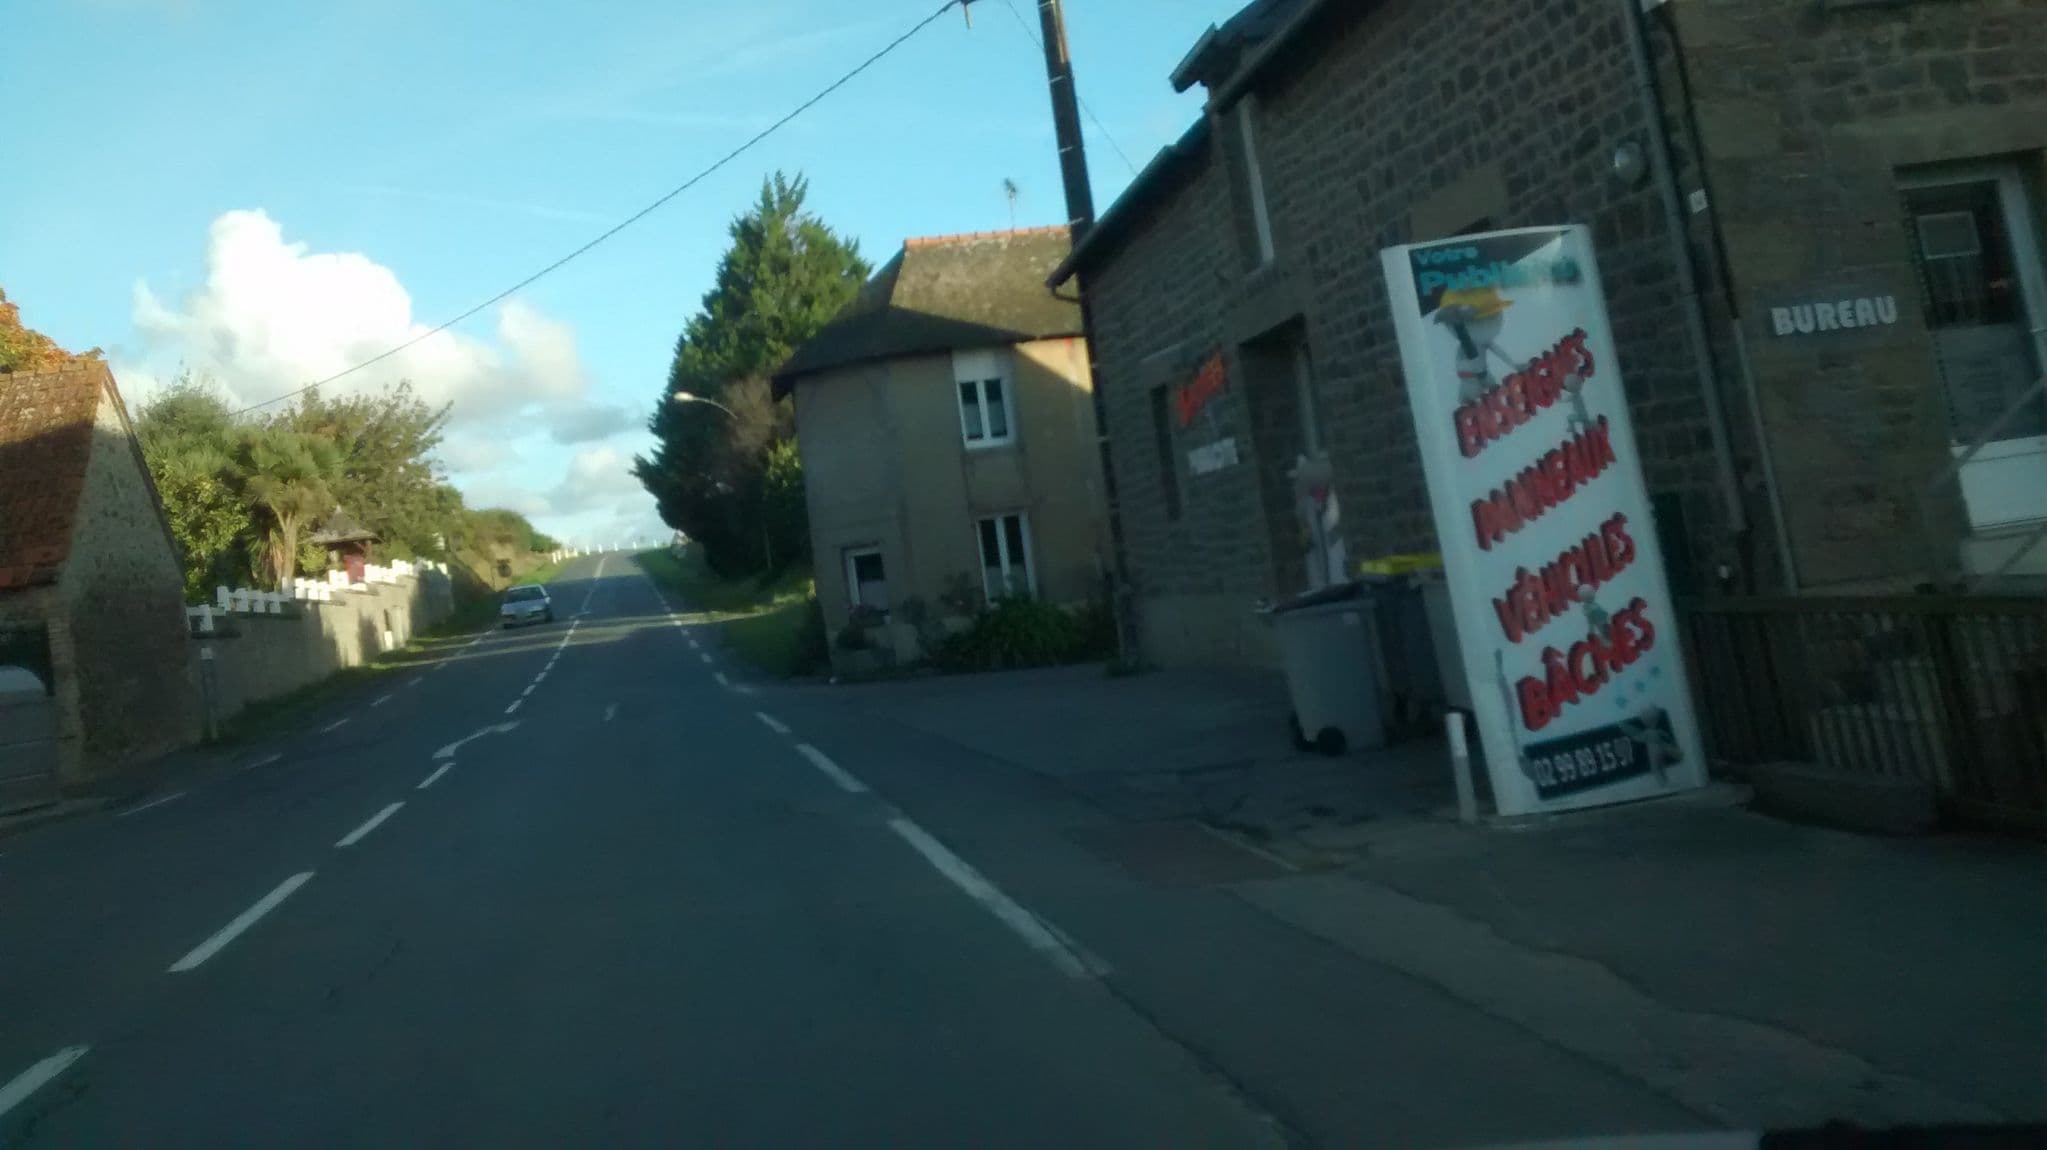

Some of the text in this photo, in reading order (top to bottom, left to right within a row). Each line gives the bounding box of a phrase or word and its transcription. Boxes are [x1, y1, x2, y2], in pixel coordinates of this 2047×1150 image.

[1771, 296, 1897, 336] BUREAU
[1454, 327, 1595, 458] ENSEIGNES
[1471, 414, 1616, 551] PANNEAUX
[1516, 597, 1655, 732] BÂCHES
